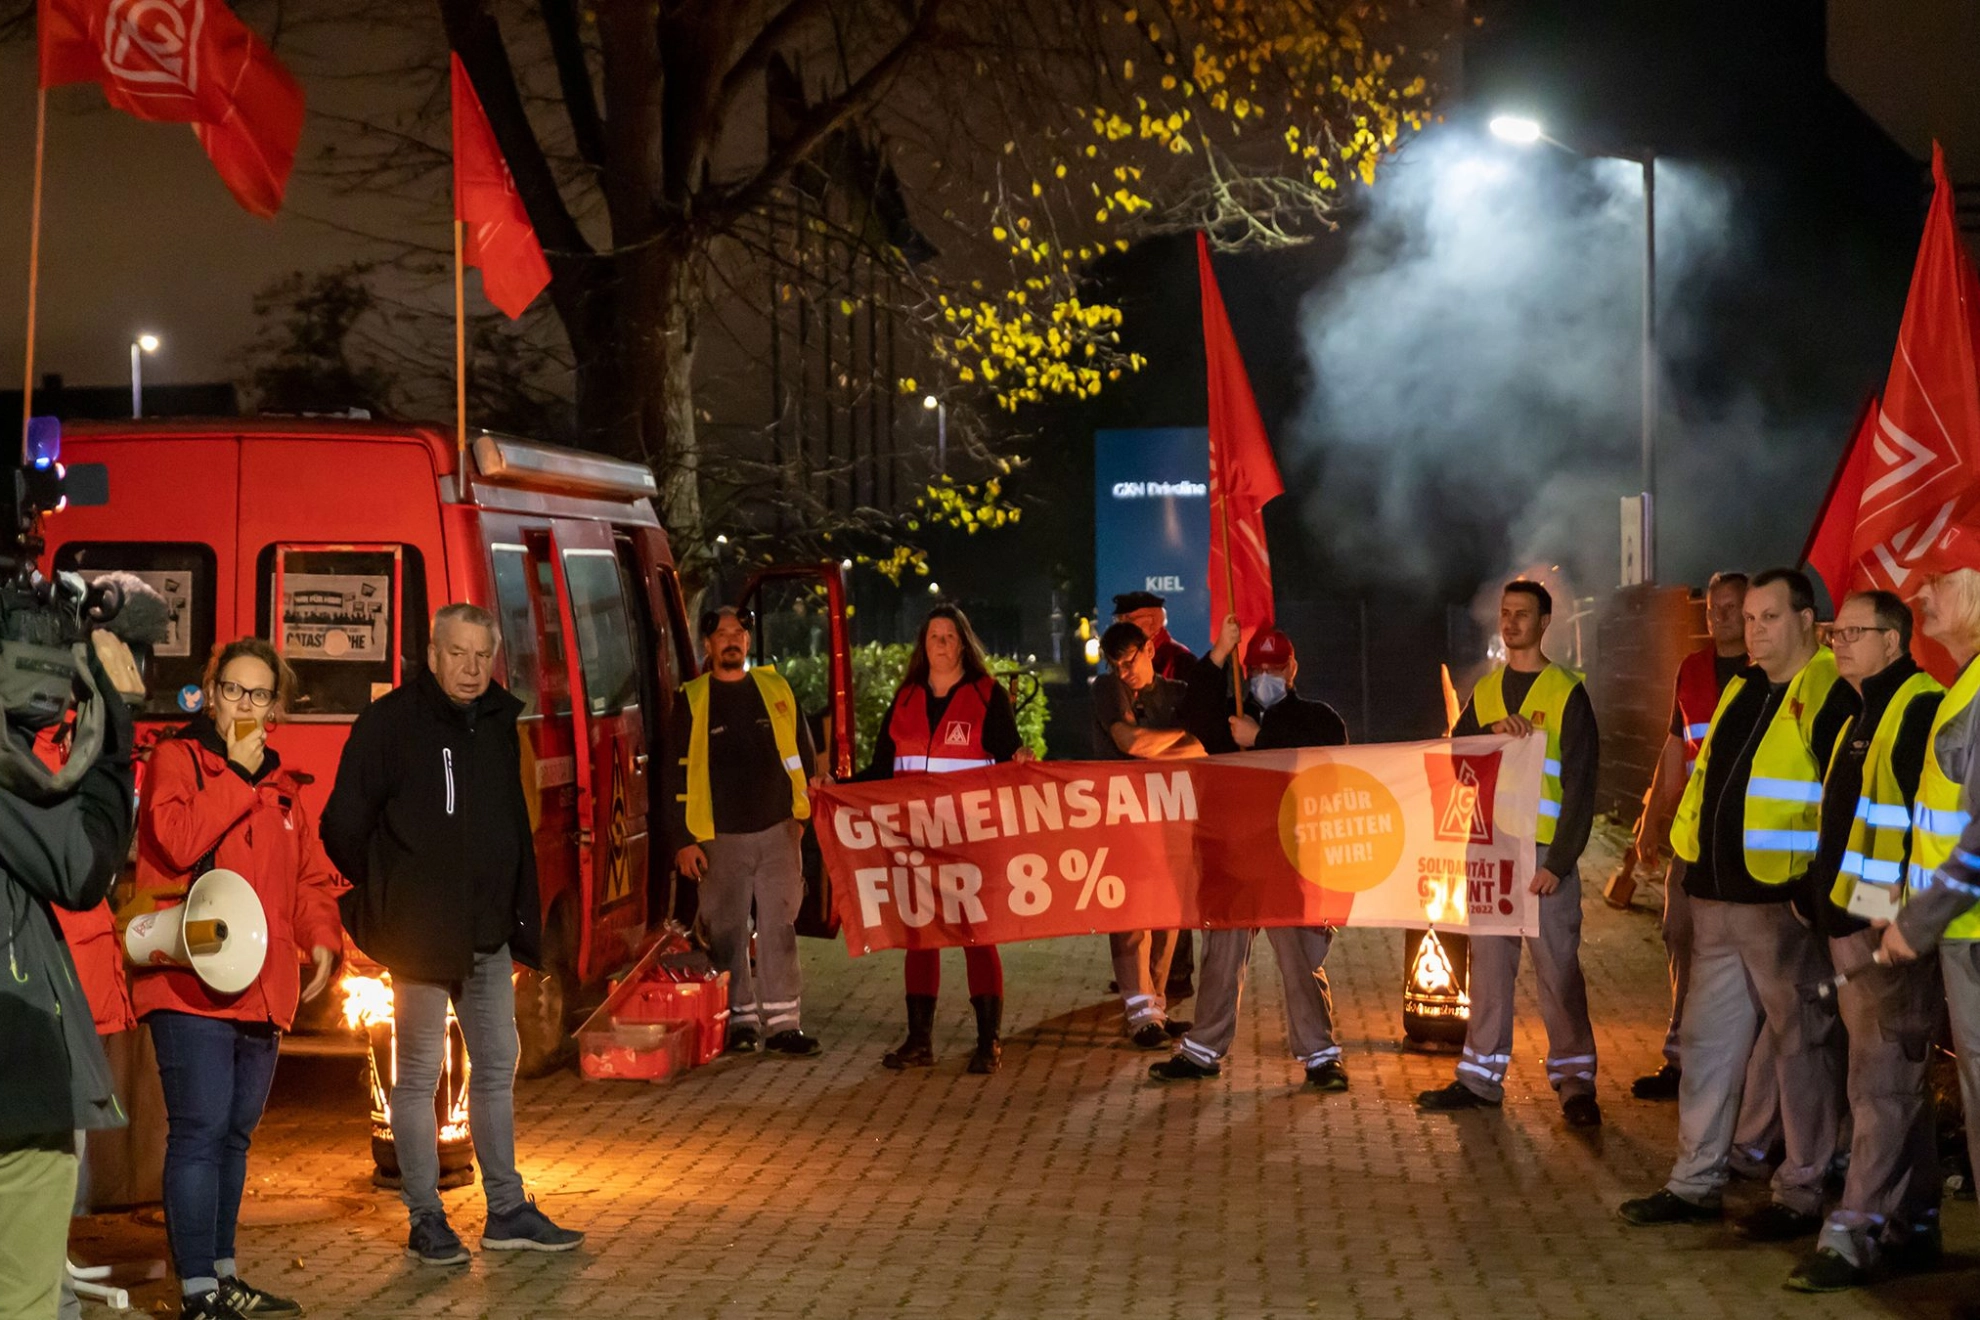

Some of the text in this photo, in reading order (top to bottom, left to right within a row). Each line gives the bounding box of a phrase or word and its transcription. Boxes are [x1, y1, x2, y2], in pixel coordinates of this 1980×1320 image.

[1145, 576, 1185, 591] KIEL
[834, 770, 1199, 849] GEMEINSAM
[1303, 787, 1372, 816] DAFÜR
[1294, 813, 1393, 844] STREITEN
[1324, 841, 1373, 867] WIR!
[855, 850, 988, 928] FÜR
[1471, 905, 1493, 914] 2022
